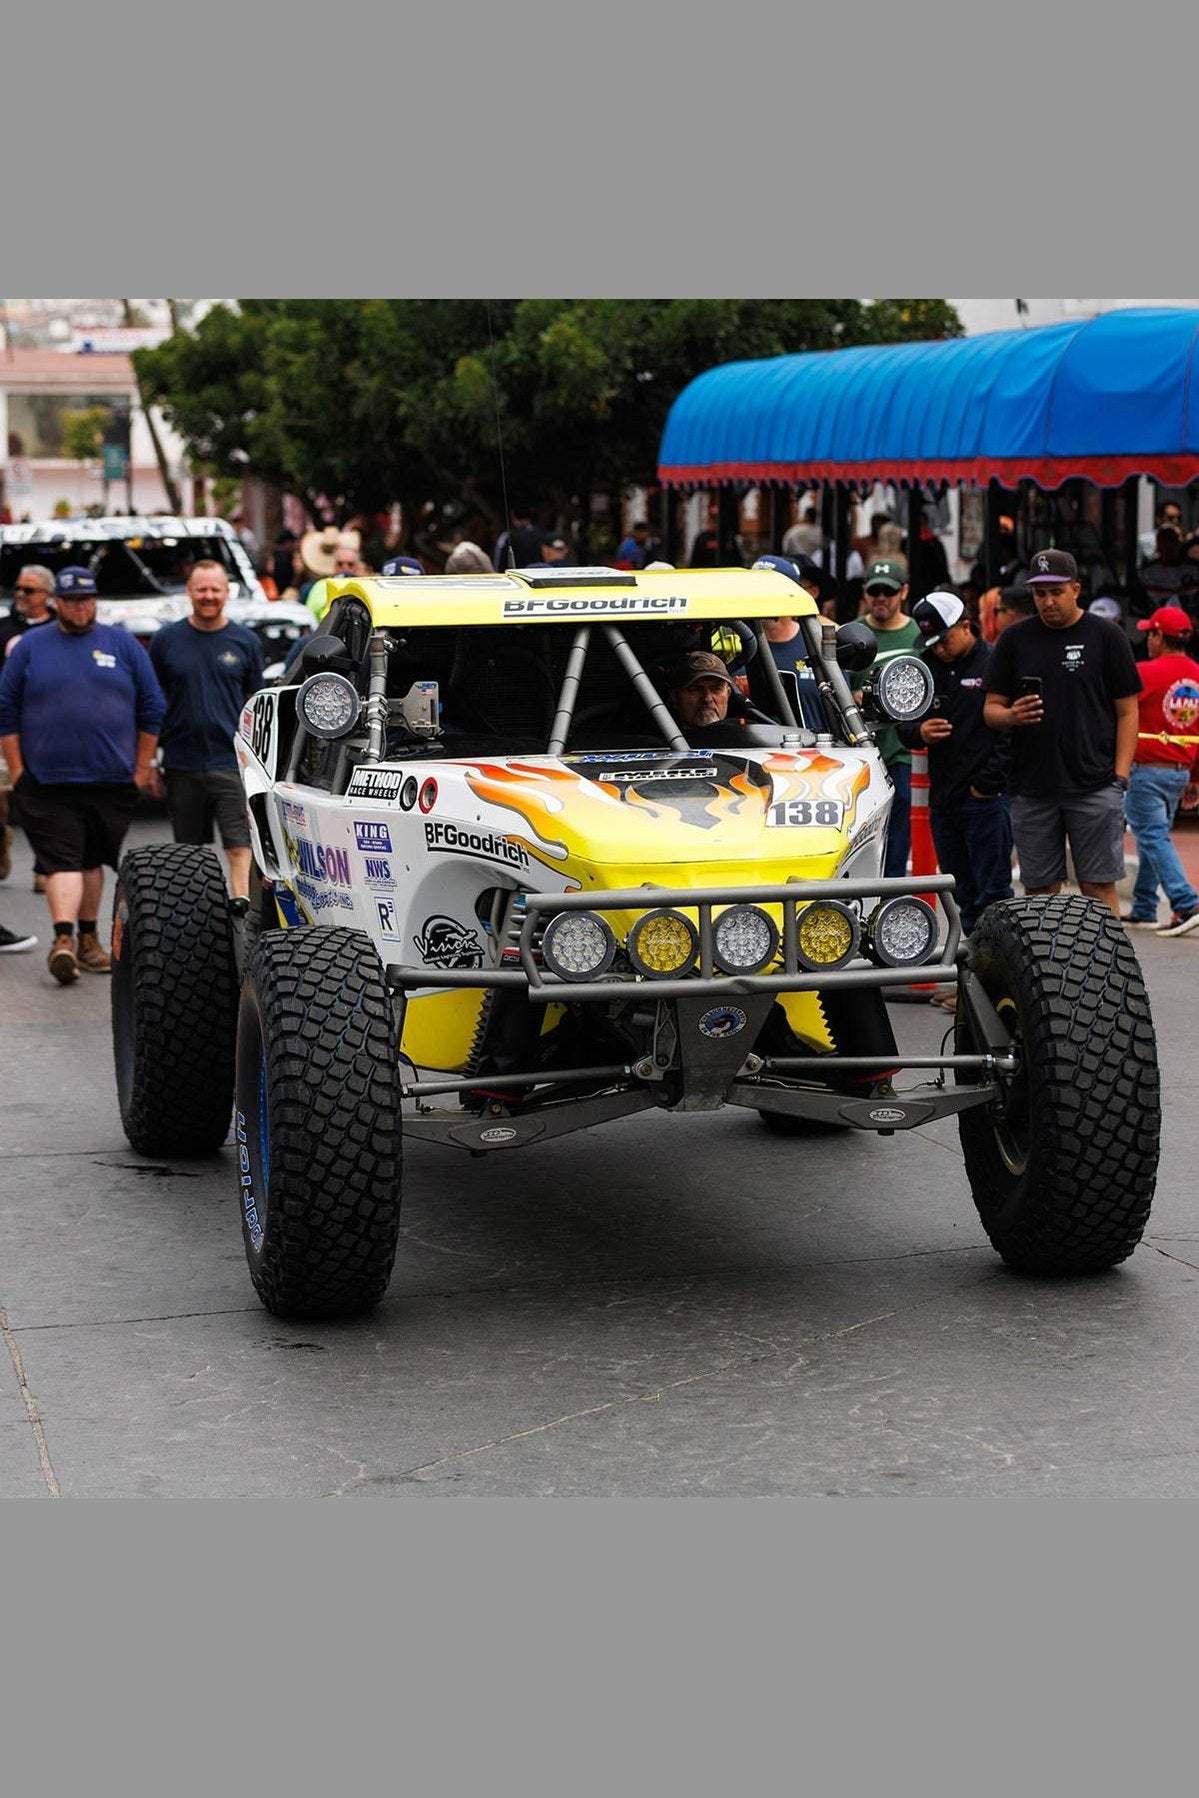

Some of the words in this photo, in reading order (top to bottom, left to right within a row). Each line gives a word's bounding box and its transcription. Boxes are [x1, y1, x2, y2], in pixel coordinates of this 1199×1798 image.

[503, 597, 687, 612] BFGoodrich
[252, 694, 273, 765] 138
[352, 769, 401, 789] METHOD
[350, 787, 366, 796] RACE
[368, 788, 397, 798] WHEELS
[770, 801, 839, 825] 138
[356, 824, 388, 839] KING
[425, 823, 530, 867] BFGoodrich
[366, 859, 391, 879] NWS
[414, 932, 484, 957] Vision
